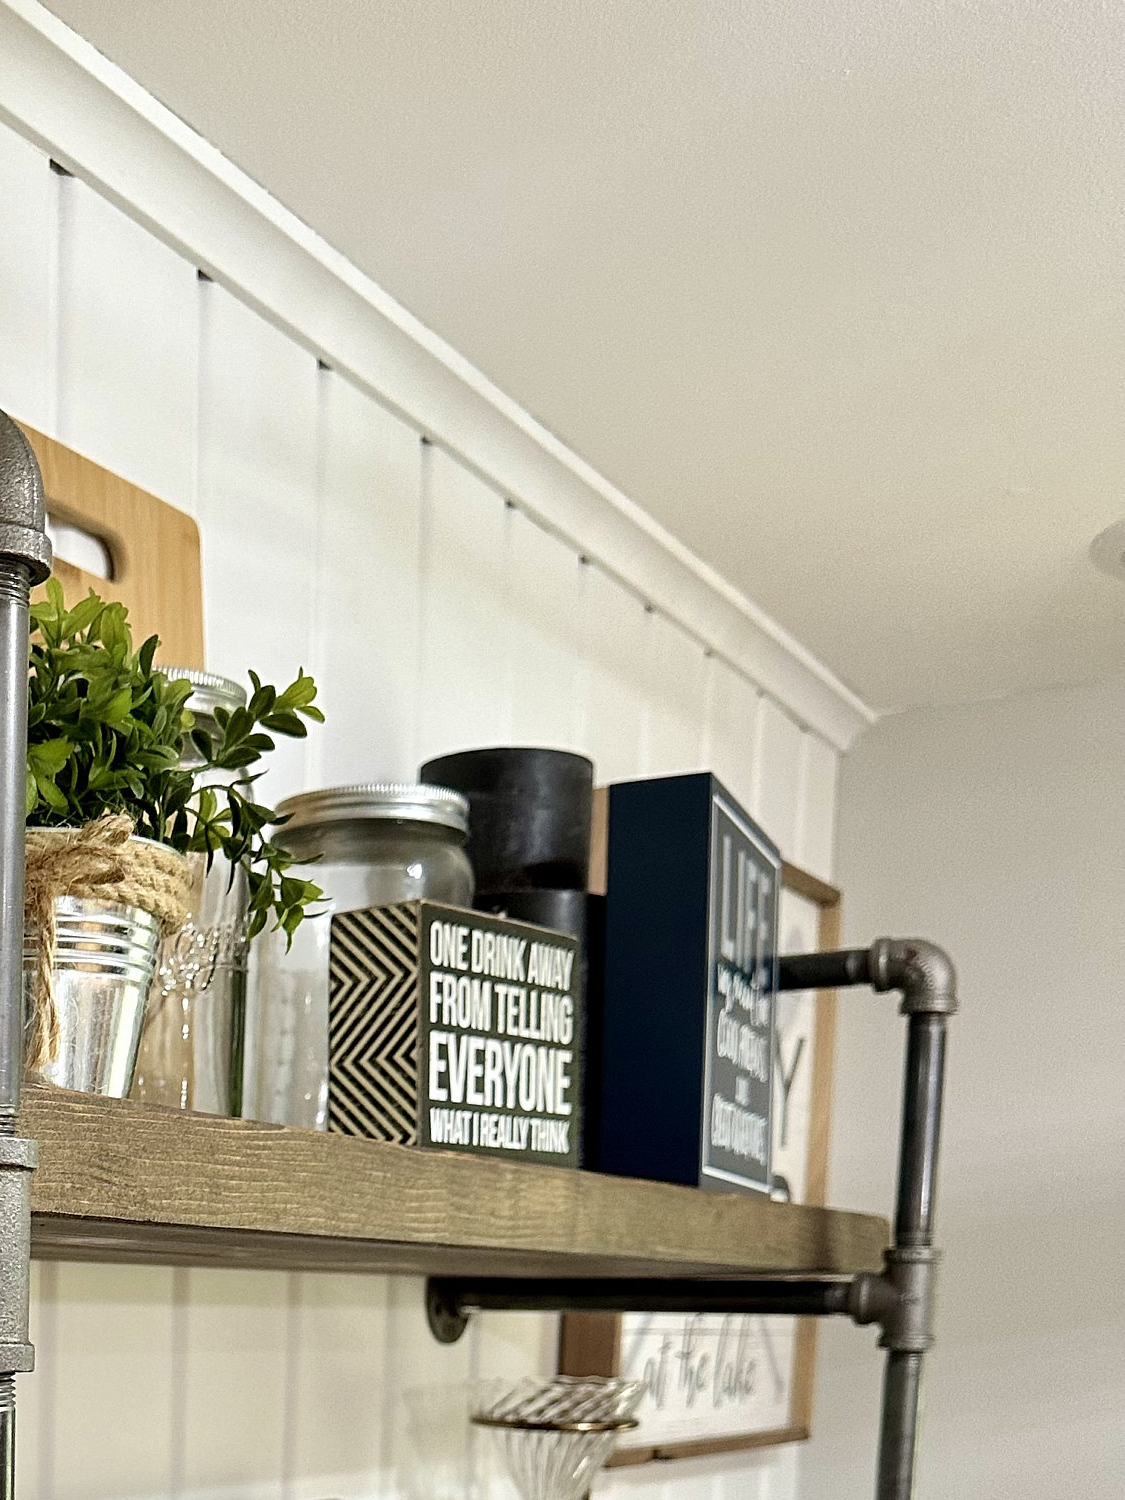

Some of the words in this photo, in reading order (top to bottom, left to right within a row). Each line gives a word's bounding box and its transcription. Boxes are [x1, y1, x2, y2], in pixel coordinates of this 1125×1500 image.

[429, 919, 470, 971] ONE
[471, 928, 527, 982] DRINK
[527, 942, 575, 992] AWAY
[429, 970, 492, 1032] FROM
[494, 983, 574, 1046] TELLING
[428, 1029, 574, 1116] EVERYONE
[429, 1106, 472, 1146] WHAT
[472, 1111, 480, 1147] I
[479, 1112, 531, 1151] REALLY
[530, 1117, 571, 1154] THINK
[712, 1312, 757, 1409] lake
